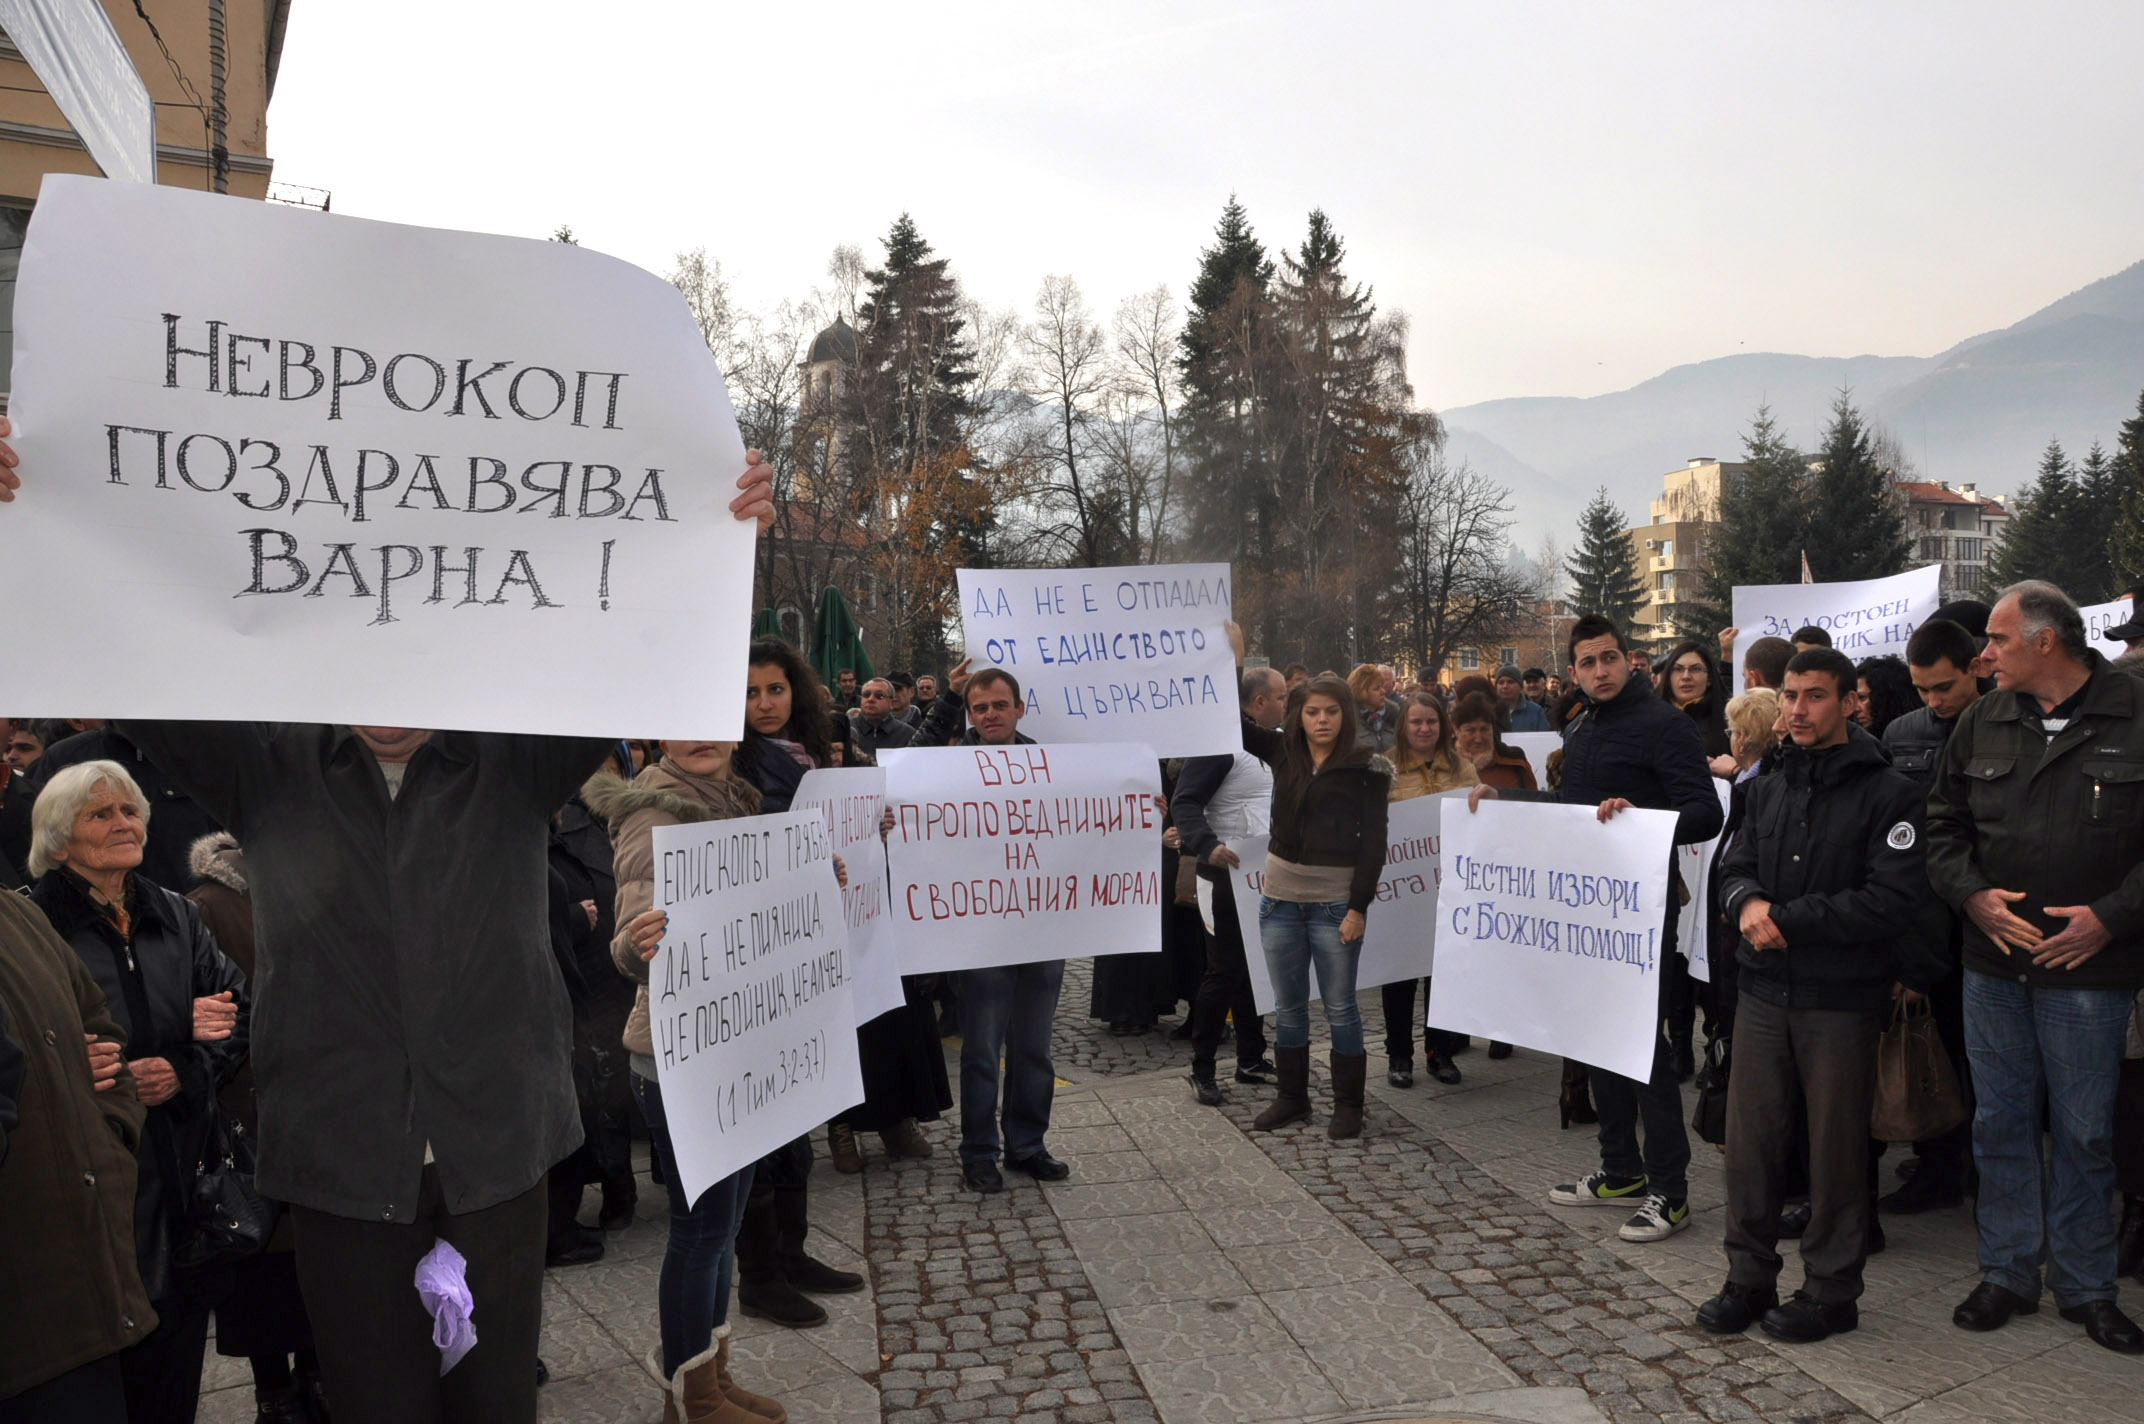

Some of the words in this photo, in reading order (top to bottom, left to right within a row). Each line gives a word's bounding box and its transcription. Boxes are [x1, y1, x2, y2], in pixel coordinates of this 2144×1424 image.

[161, 313, 628, 430] НЕВРОКОП
[104, 424, 678, 522] ПОЗДРАВЯВА
[232, 528, 566, 627] ВАРНА
[973, 587, 1012, 618] ДА
[1035, 585, 1065, 615] НЕ
[1082, 584, 1098, 612] Е
[1116, 577, 1229, 610] ОТПАДАЛ
[986, 639, 1016, 665] ОТ
[1038, 628, 1206, 666] ЕДИНСТВОТО
[1762, 615, 1792, 636] ЗА
[1832, 628, 1877, 651] НИК
[1025, 688, 1041, 715] А
[1064, 674, 1218, 720] ЦЪРКВАТА
[975, 748, 1051, 786] ВЪН
[900, 794, 1152, 843] ПРОПОВЕДНИЦИТЕ
[664, 831, 770, 906] ЕПИСКОПЪТ
[1005, 842, 1040, 870] НА
[907, 875, 1078, 921] СВОБОДНИЯ
[1091, 871, 1158, 907] МОРАЛ
[1456, 855, 1536, 899] ЧЕСТНИ
[1548, 870, 1640, 919] ИЗБОРИ
[661, 942, 690, 1004] ДА
[700, 932, 710, 981] Е
